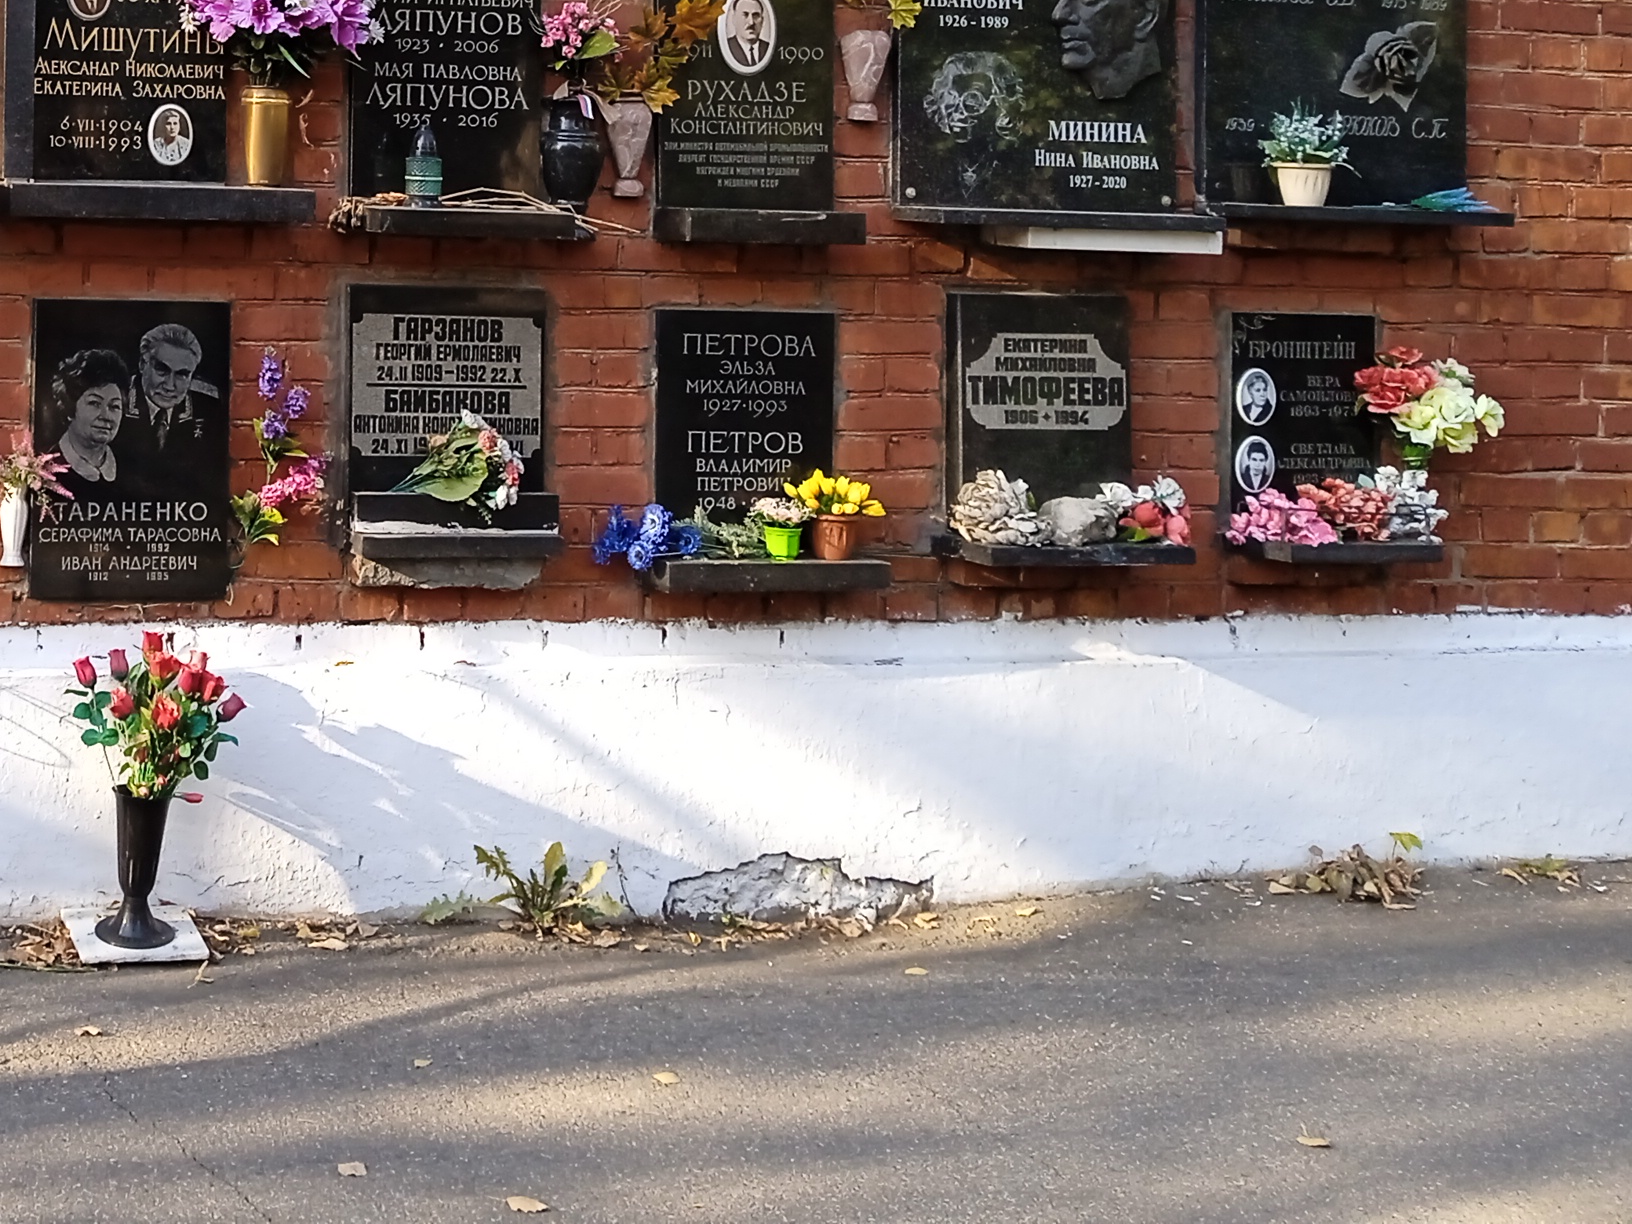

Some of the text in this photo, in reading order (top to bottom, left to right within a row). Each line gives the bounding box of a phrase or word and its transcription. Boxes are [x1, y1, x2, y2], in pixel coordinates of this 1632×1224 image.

[377, 7, 522, 36] ЛЯПУНОВ
[777, 47, 824, 64] 1990
[375, 62, 522, 82] МАЯ ПАВЛОВНА
[366, 82, 530, 110] ЛЯПУНОВА
[688, 80, 806, 105] РУХАДЗЕ
[1048, 120, 1147, 144] МИНИНА
[393, 317, 503, 343] ГАРЗАНОВ
[376, 343, 521, 363] ГЕОРГИЙ ЕРМОЛАЕВИЧ
[682, 333, 816, 357] ПЕТРОВА
[1003, 338, 1088, 354] ЕКАТЕРИНА
[1249, 334, 1356, 360] БРОНШТЕЙН
[719, 360, 776, 376] ЭЛЬЗА
[995, 354, 1096, 373] МИХАЙЛОВНА
[686, 379, 806, 395] МИХАЙЛОВНА
[969, 376, 1124, 406] ТИМОФЕЕВА
[1307, 375, 1341, 388] ВЕРА
[354, 415, 418, 433] АНТОНИНА
[687, 430, 803, 454] ПЕТРОВ
[1290, 443, 1355, 455] СВЕТЛАНА
[696, 458, 791, 476] ВЛАДИМИР
[54, 502, 208, 522] ТАРАНЕНКО
[39, 528, 221, 543] СЕРАФИМА ТАРАСОВНА
[62, 556, 197, 570] ИВАН АНДРЕЕВИЧ
